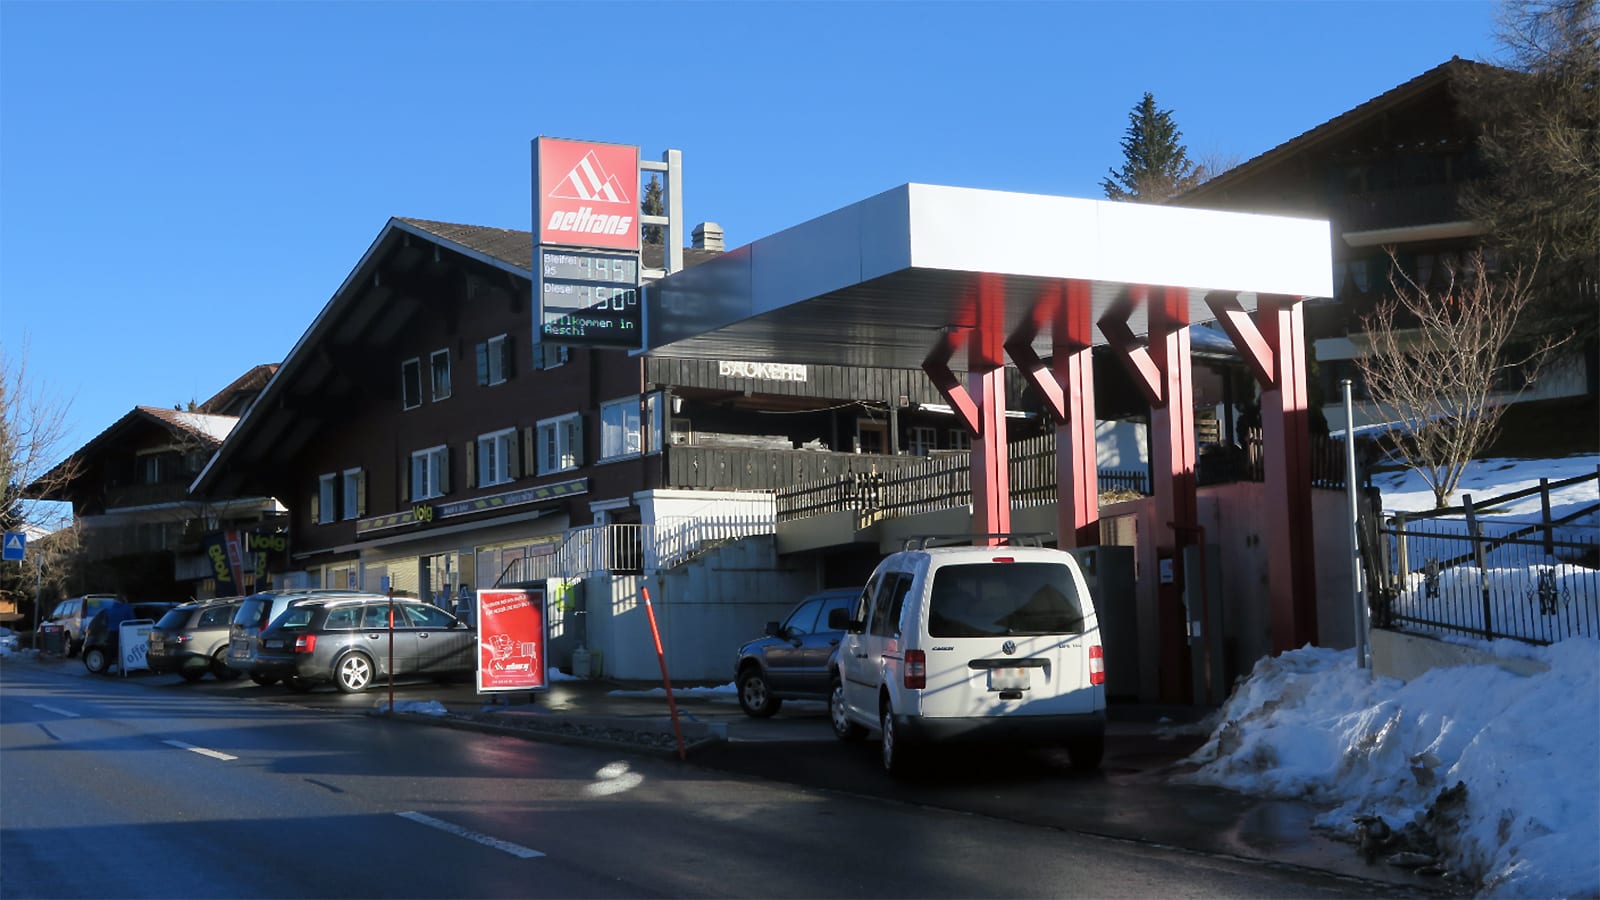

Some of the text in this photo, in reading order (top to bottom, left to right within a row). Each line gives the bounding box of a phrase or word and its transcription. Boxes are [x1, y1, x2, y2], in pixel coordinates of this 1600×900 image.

[544, 253, 577, 265] Bleifrei
[544, 265, 557, 276] 95
[544, 282, 574, 294] Diesel
[620, 318, 634, 329] in
[544, 325, 585, 336] Aeschi
[413, 504, 433, 522] Volg
[249, 534, 286, 551] Volg
[127, 643, 147, 663] offe
